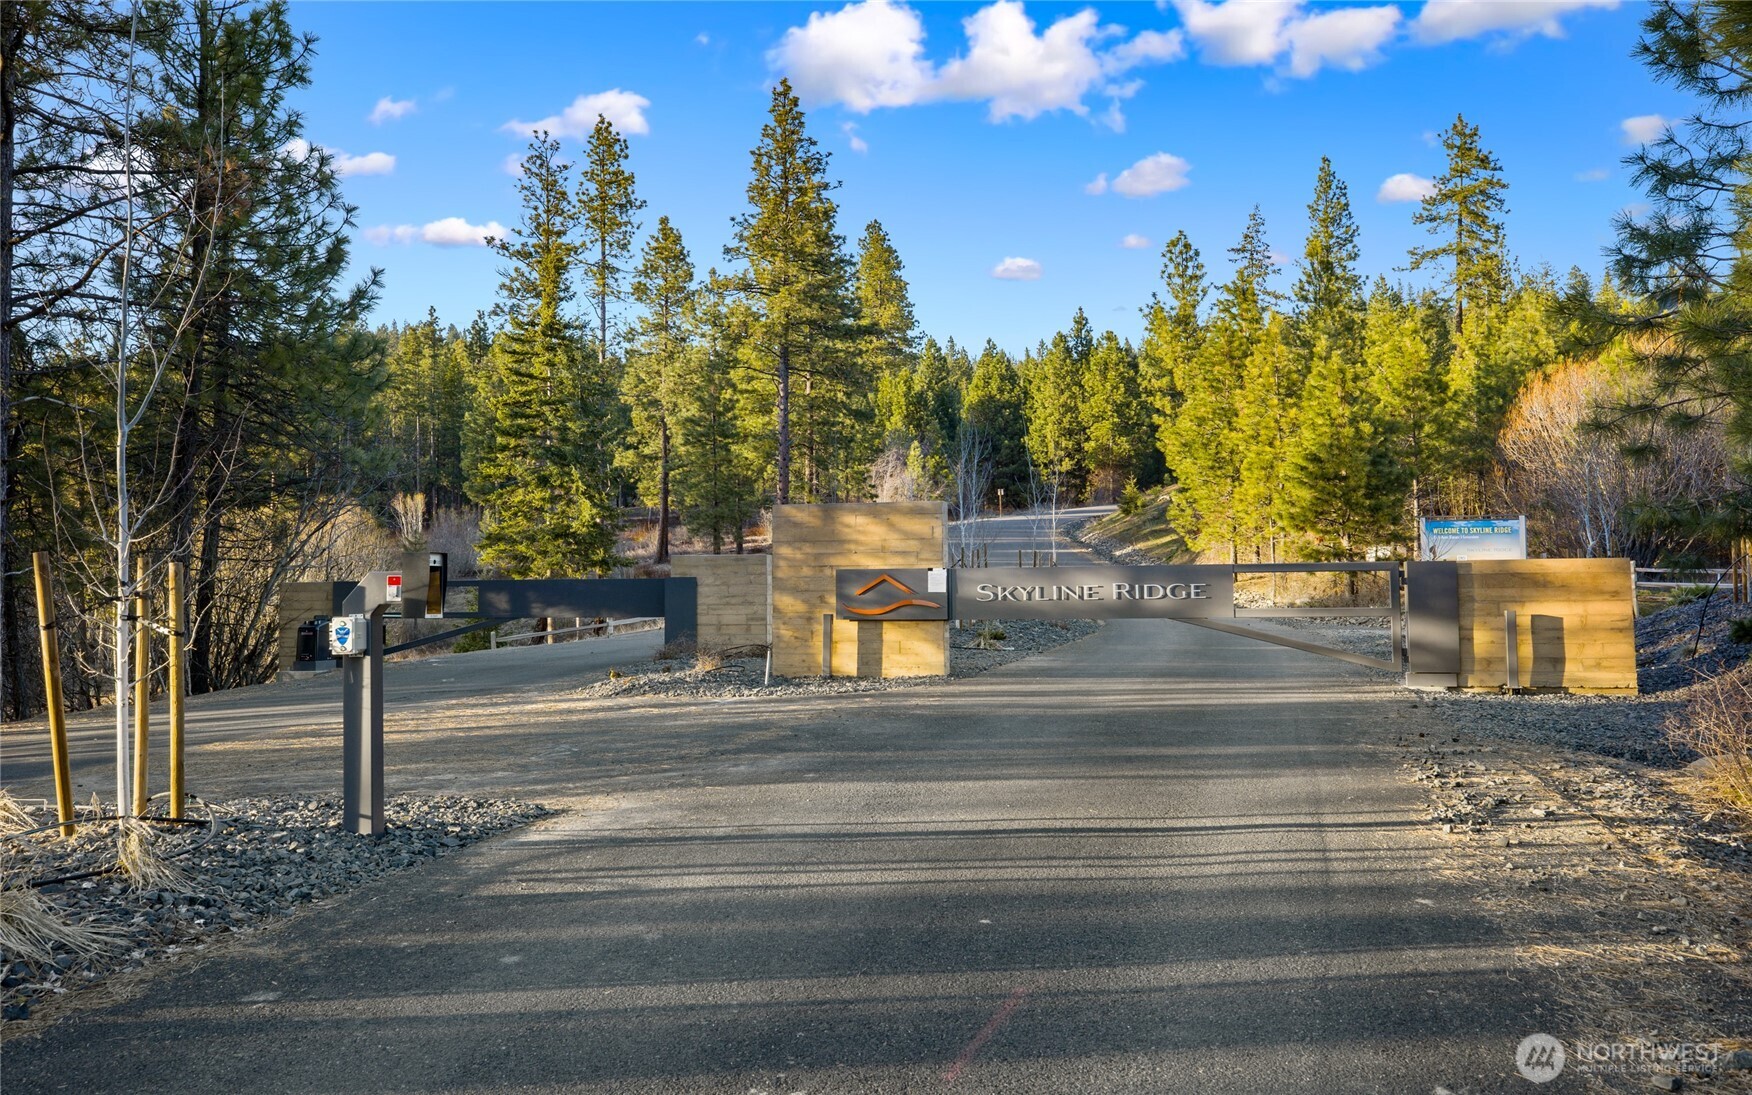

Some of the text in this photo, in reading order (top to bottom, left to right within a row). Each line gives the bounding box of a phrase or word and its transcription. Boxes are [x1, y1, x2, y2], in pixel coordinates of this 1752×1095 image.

[1433, 527, 1459, 535] WELCOME
[1461, 527, 1468, 535] TO
[1494, 526, 1512, 534] RIDGE
[976, 582, 1207, 601] SKYLINE RIDGE
